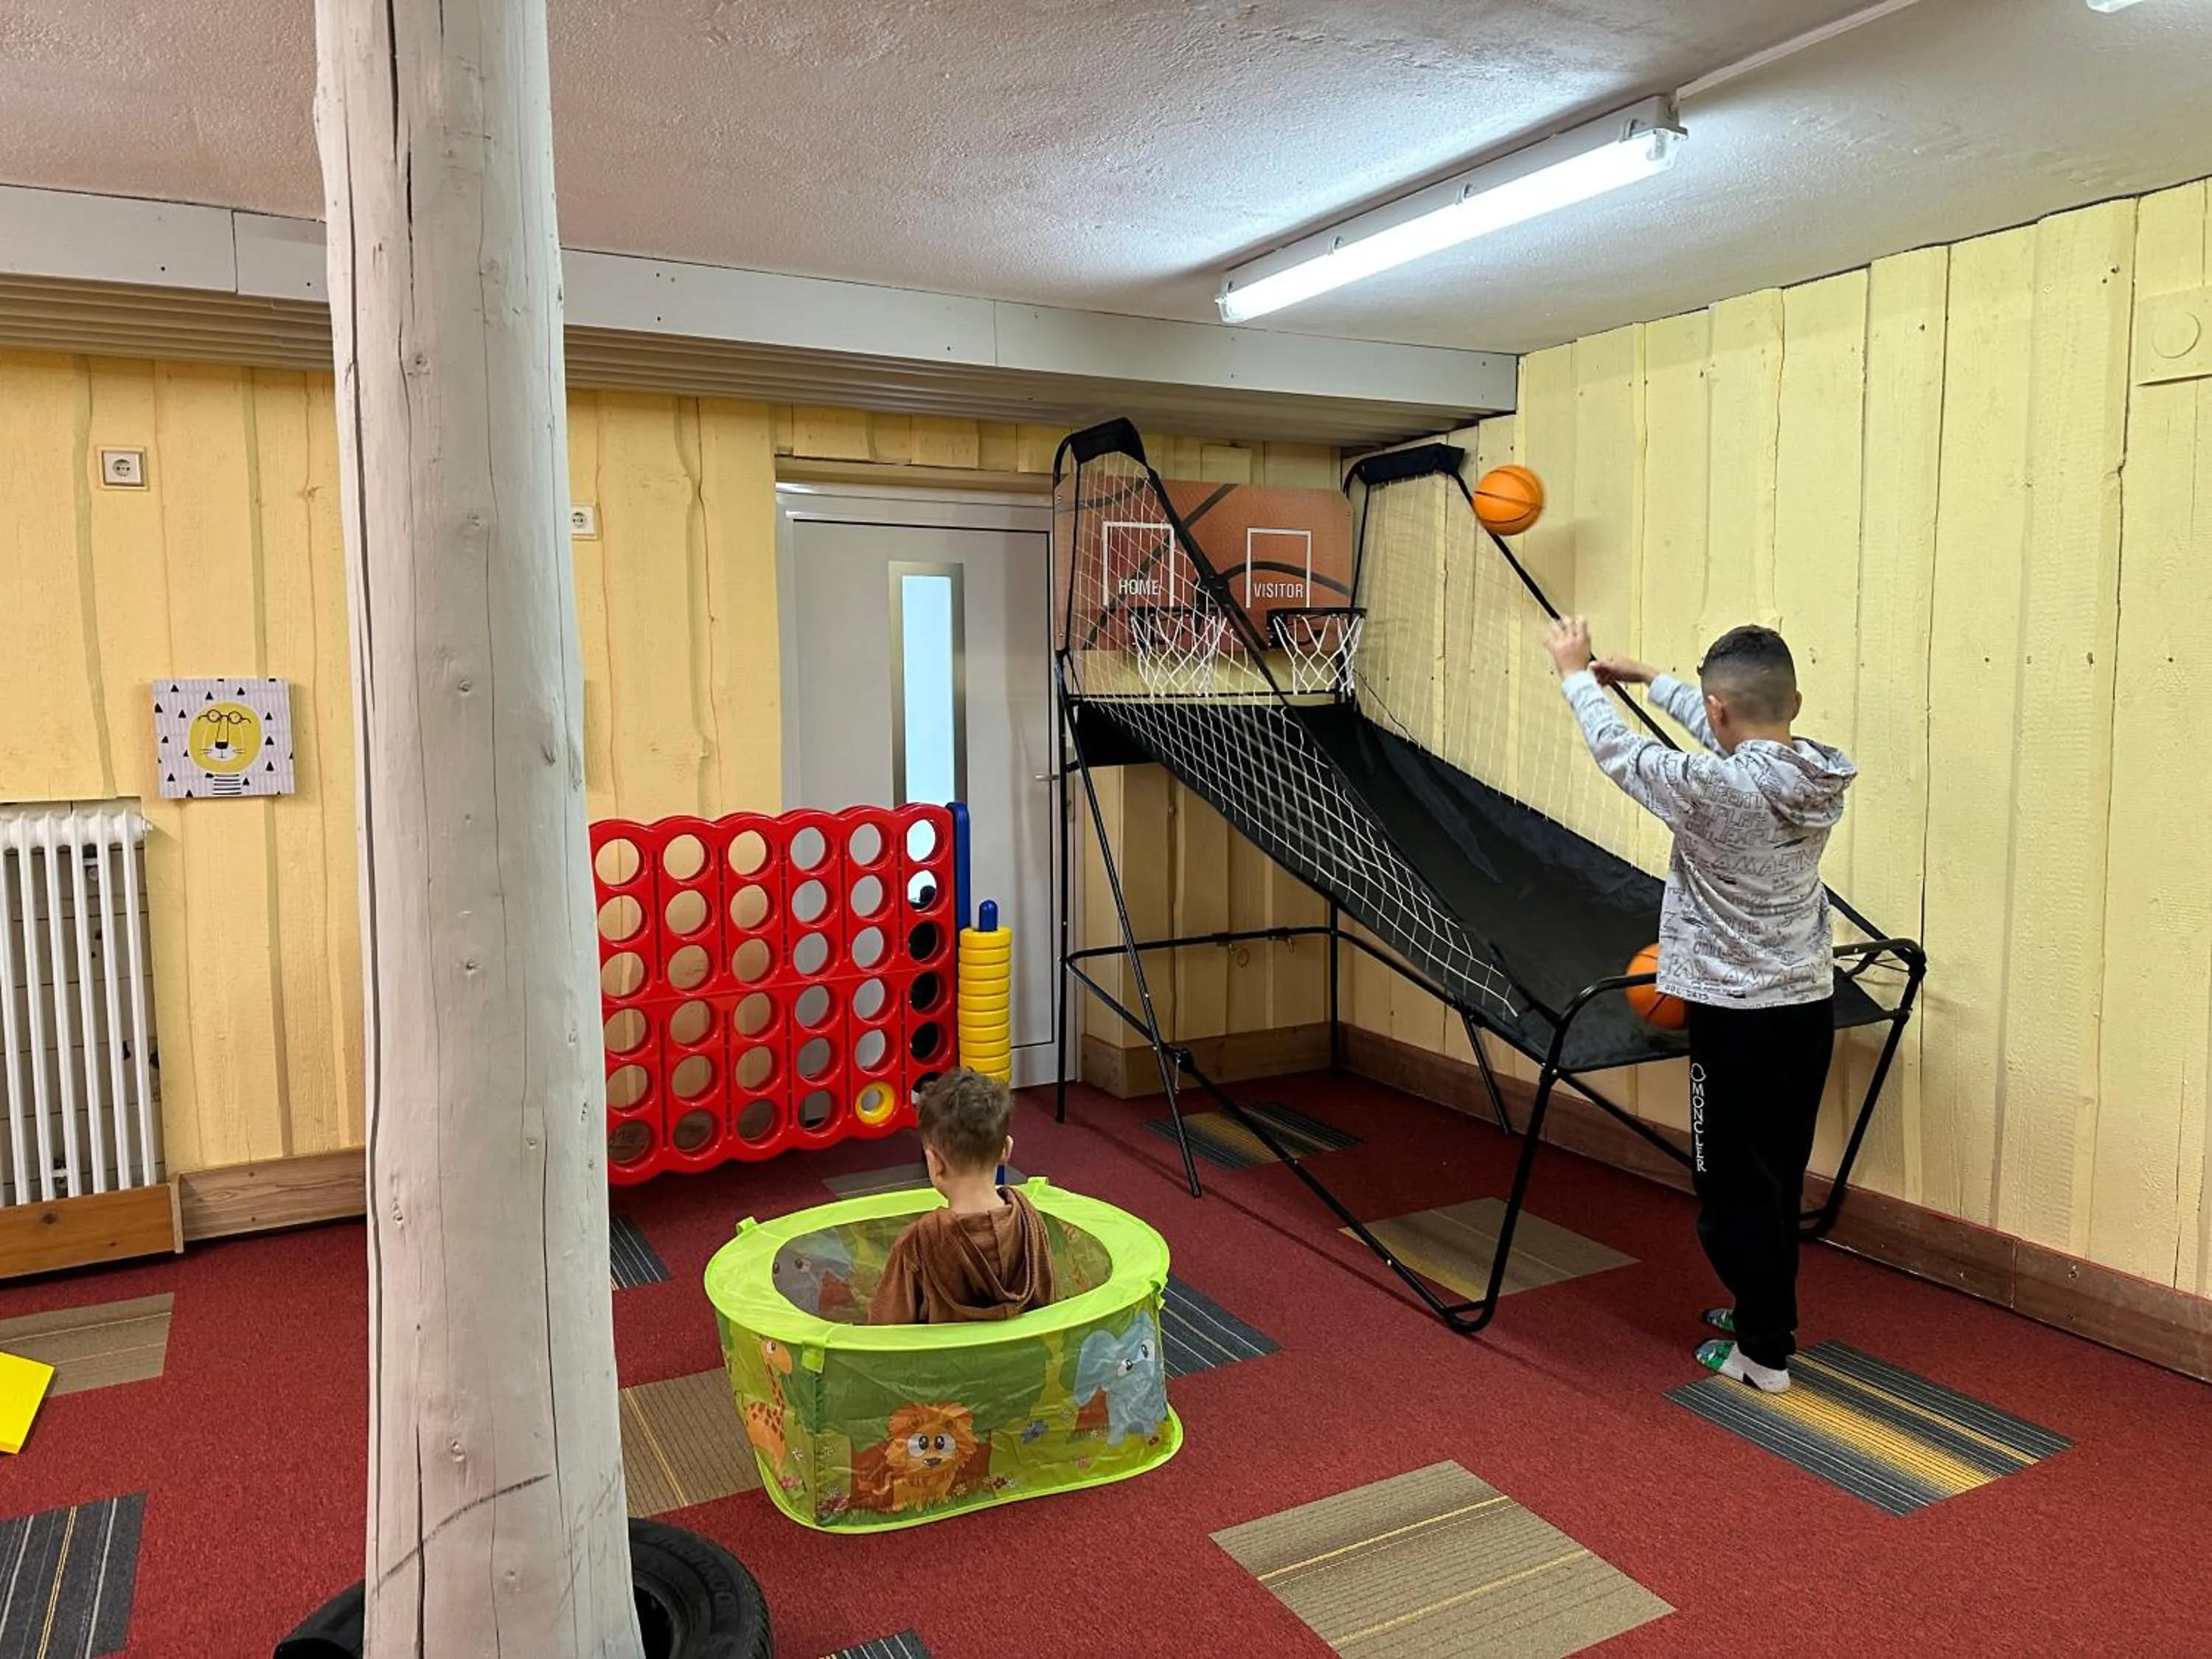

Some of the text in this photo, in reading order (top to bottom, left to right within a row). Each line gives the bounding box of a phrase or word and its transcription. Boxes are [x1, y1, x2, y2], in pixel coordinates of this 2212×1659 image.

[1118, 579, 1160, 596] HOME
[1253, 582, 1304, 599] VISITOR
[1691, 1082, 1707, 1173] MONCLER
